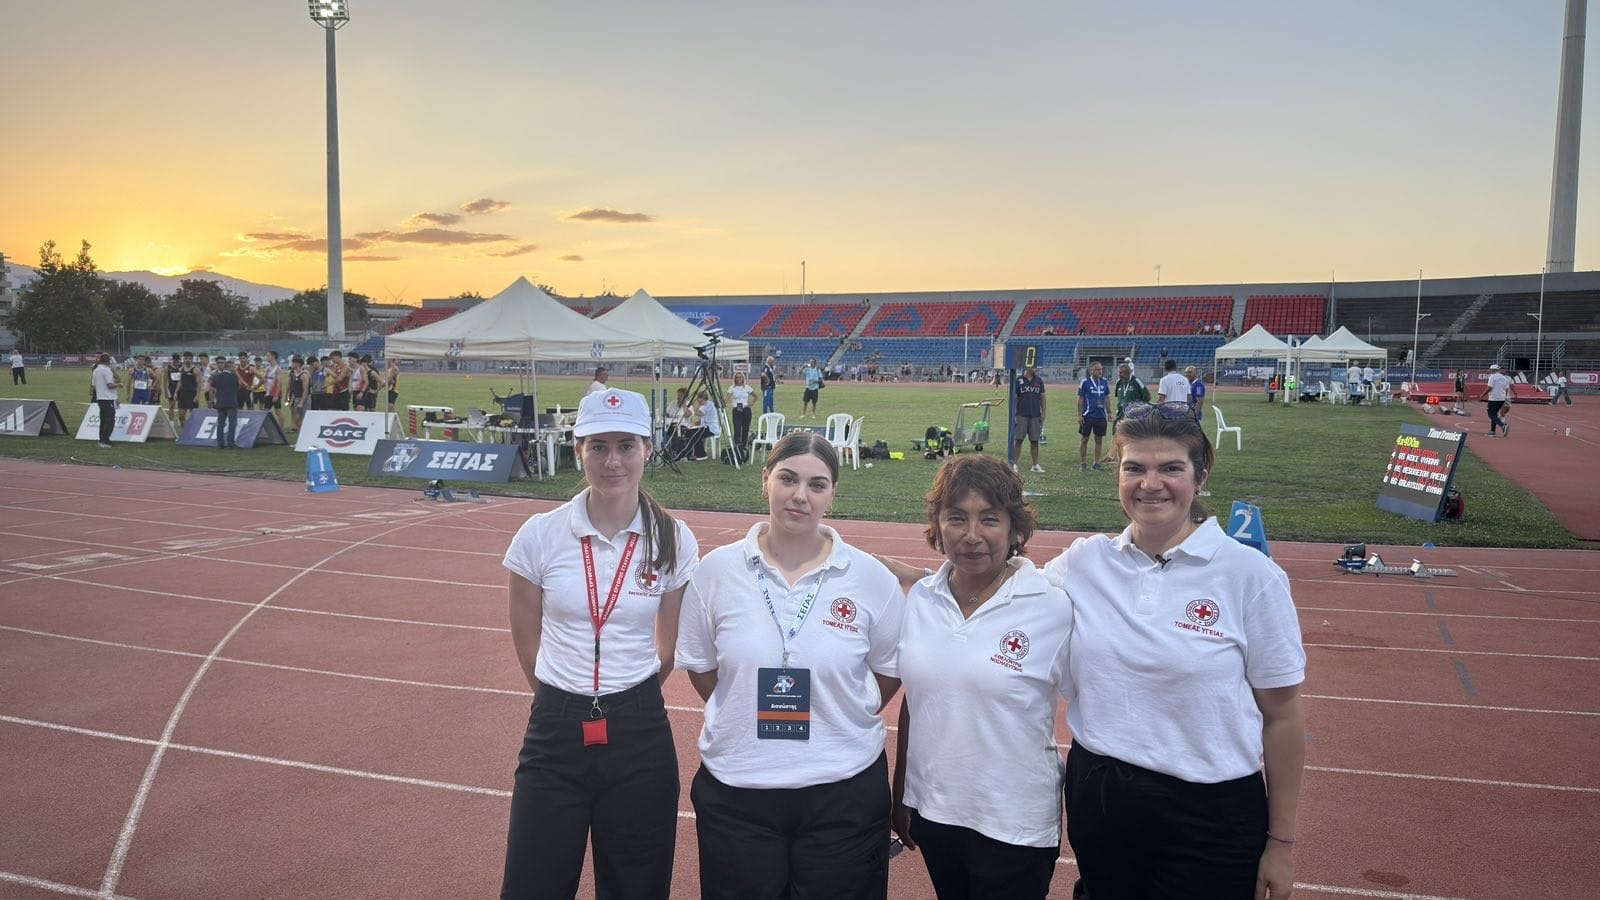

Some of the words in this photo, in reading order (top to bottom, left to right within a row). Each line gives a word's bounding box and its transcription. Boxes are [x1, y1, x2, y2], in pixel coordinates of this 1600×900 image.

[1025, 346, 1036, 368] 0
[89, 415, 128, 425] COTE
[1427, 427, 1462, 442] TimeTronics
[317, 453, 325, 472] 1
[426, 451, 499, 471] ΣΕΓΑΣ
[1234, 508, 1252, 539] 2
[797, 592, 815, 620] ΣΕΓΑΣ
[822, 620, 843, 630] ΤΟΜΕΑΣ
[1174, 620, 1200, 632] ΤΟΜΕΑΣ
[1202, 627, 1224, 637] ΥΓΕΙΑΣ
